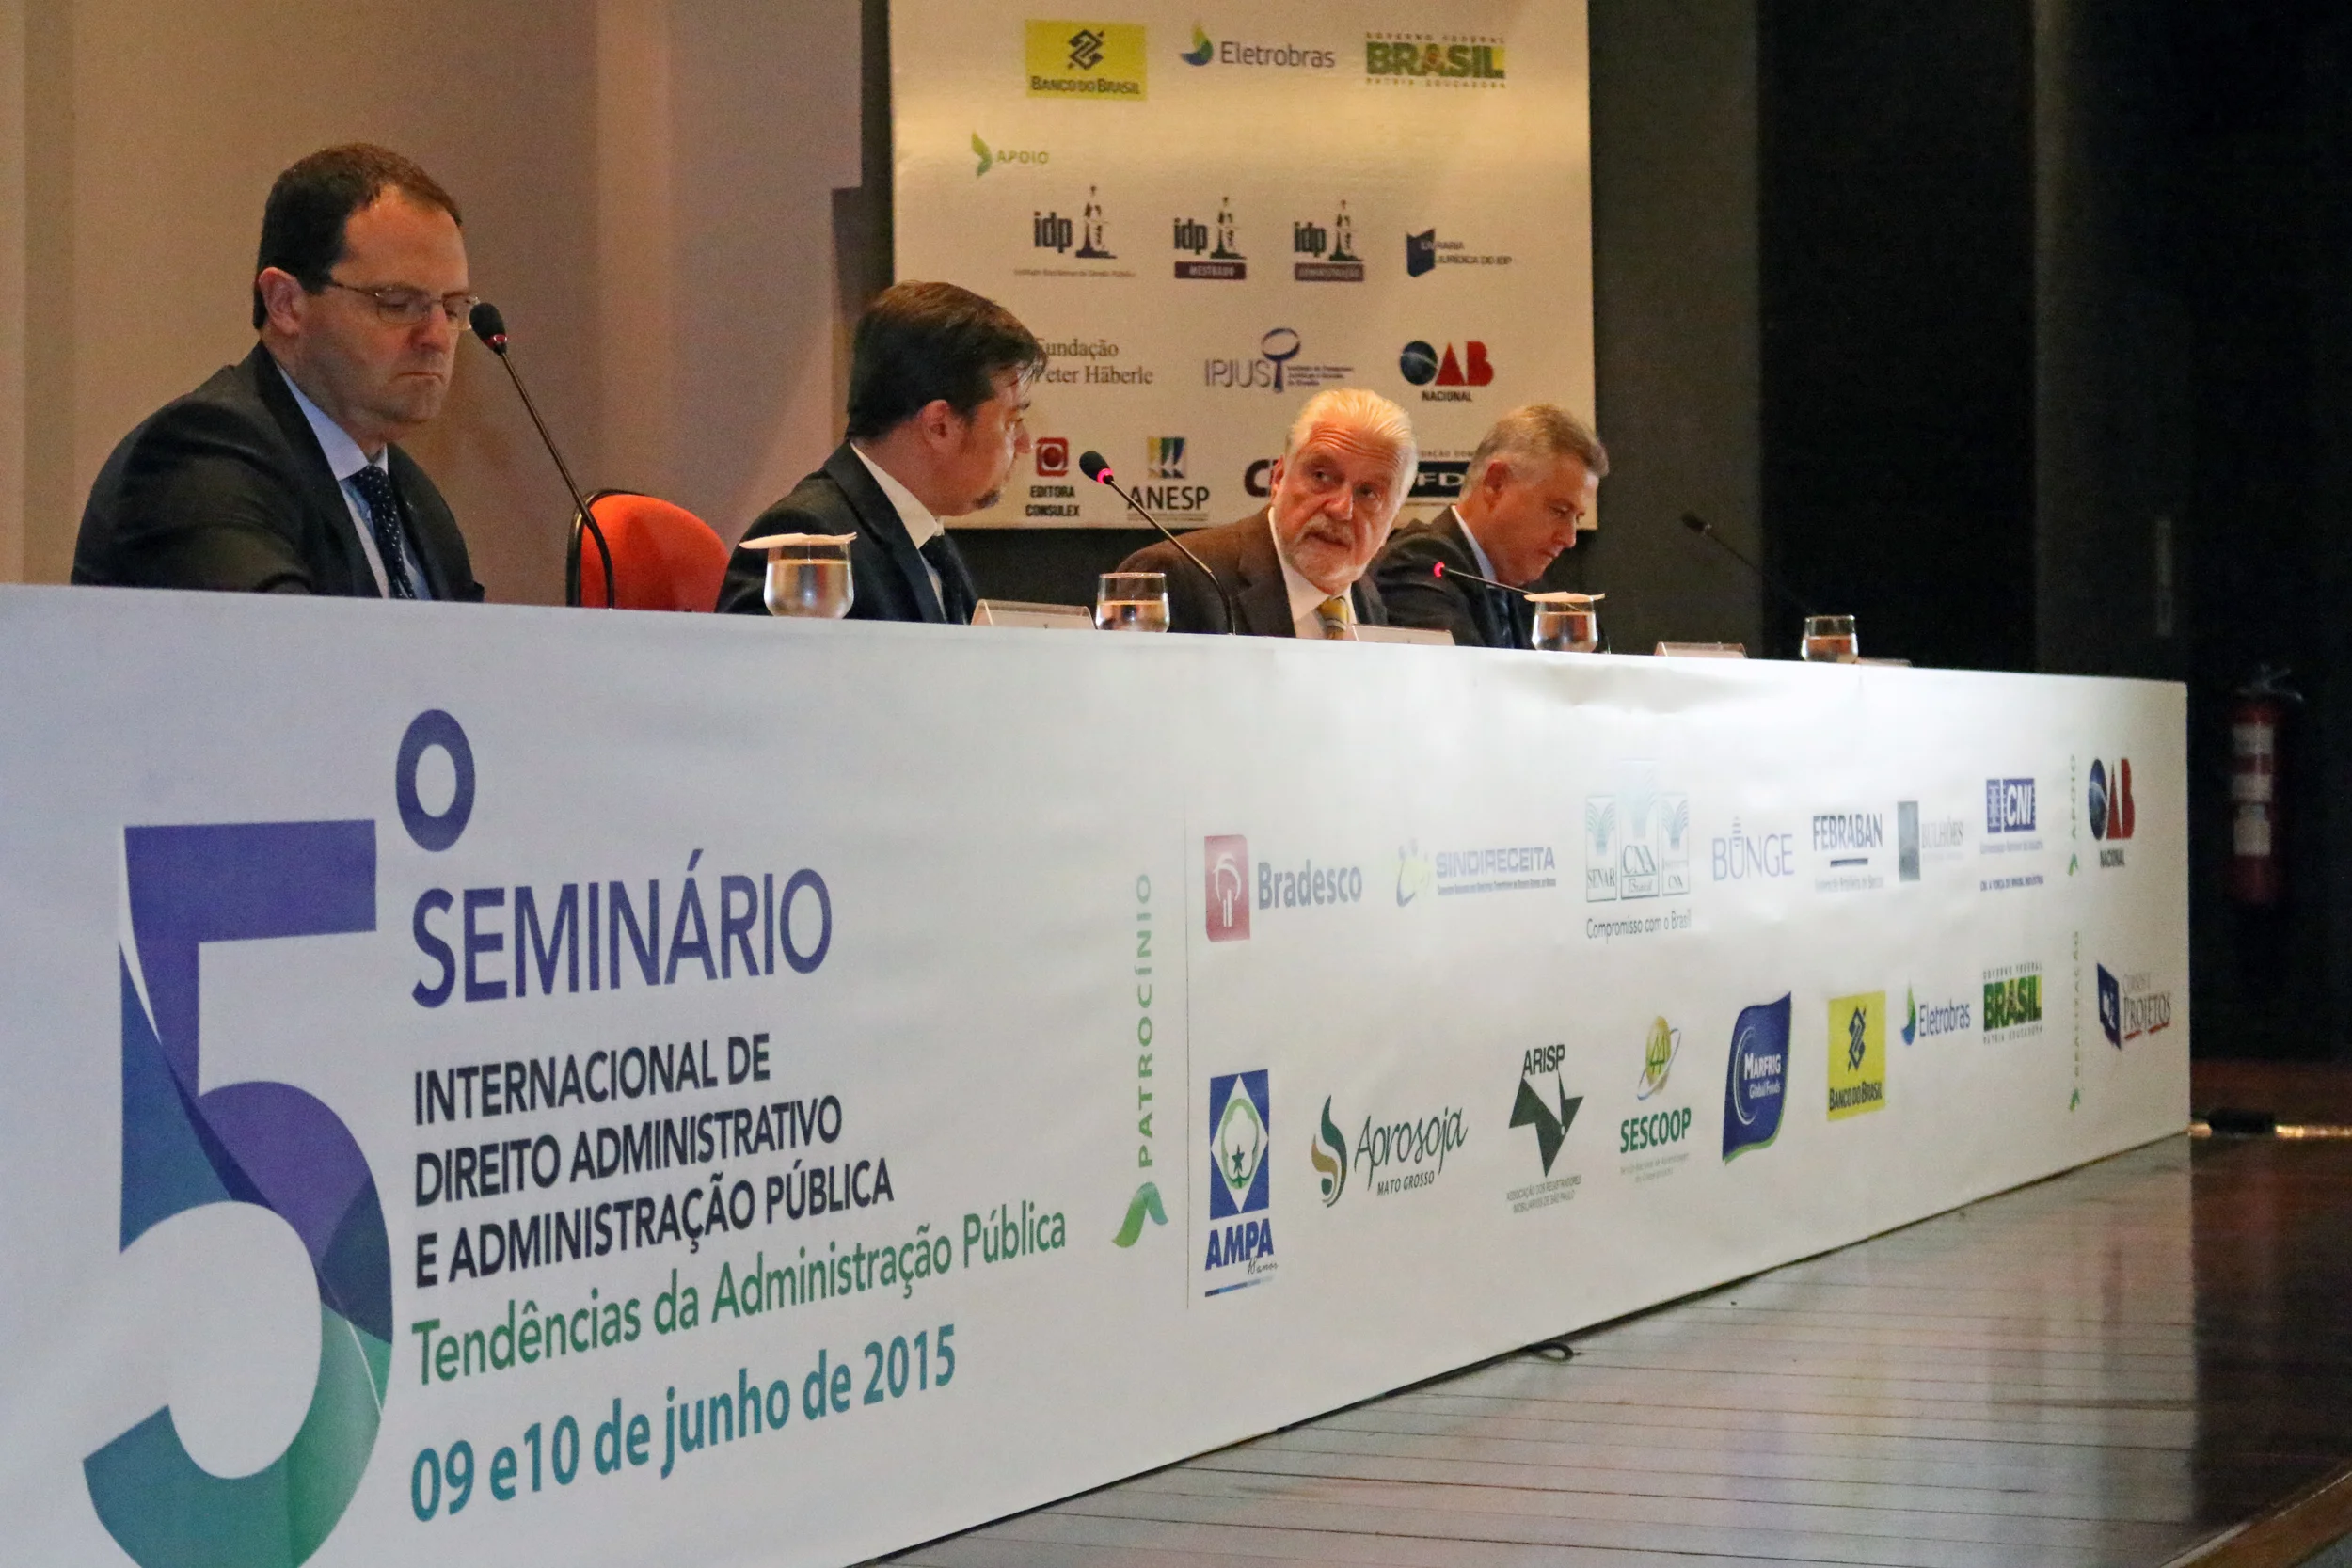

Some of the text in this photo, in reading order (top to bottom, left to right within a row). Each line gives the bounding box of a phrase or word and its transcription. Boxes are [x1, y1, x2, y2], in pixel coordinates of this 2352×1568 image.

[1220, 41, 1335, 69] Eletrobras
[1366, 41, 1505, 79] BRASIL
[996, 150, 1049, 165] APOIO
[1034, 211, 1073, 253] idp
[1174, 217, 1208, 255] idp
[1295, 221, 1327, 258] idp
[1035, 338, 1120, 360] undação
[1400, 341, 1494, 387] OAB
[1422, 390, 1472, 402] NACIONAL
[1030, 485, 1075, 499] EDITORA
[1127, 485, 1210, 510] ANESP
[1418, 472, 1466, 487] FD
[1025, 504, 1080, 517] CONSULEX
[2007, 785, 2032, 825] CNI
[2088, 756, 2136, 841] OAB
[1813, 813, 1883, 851] FEBRABAN
[1436, 847, 1556, 879] SINDIRECEITA
[1712, 833, 1795, 882] BUNGE
[1258, 858, 1362, 910] Bradesco
[1587, 867, 1615, 889] SENAR
[412, 848, 832, 1008] SEMINÁRIO
[1586, 913, 1644, 944] Compromisso
[1645, 917, 1662, 933] com
[1663, 916, 1669, 930] o
[1135, 874, 1153, 1168] PATROCÍNIO
[1919, 997, 1971, 1038] Eletrobras
[1983, 974, 2042, 1033] BRASIL
[1522, 1044, 1565, 1075] ARISP
[1744, 1053, 1781, 1080] MARFRIG
[415, 1033, 770, 1126] INTERNACIONAL DE
[1354, 1106, 1469, 1191] Aprosoja
[1620, 1107, 1692, 1154] SESCOOP
[415, 1095, 842, 1207] DIREITO ADMINISTRATIVO
[1377, 1170, 1435, 1196] MATO GROSSO
[416, 1157, 894, 1289] E ADMINISTRAÇÃO PÚBLICA
[1205, 1218, 1274, 1271] AMPA
[412, 1200, 1066, 1385] Tendências da Administração Pública
[411, 1440, 474, 1522] 09
[594, 1398, 650, 1475] de
[660, 1368, 790, 1479] junho
[803, 1349, 851, 1420] de
[864, 1324, 955, 1405] 2015
